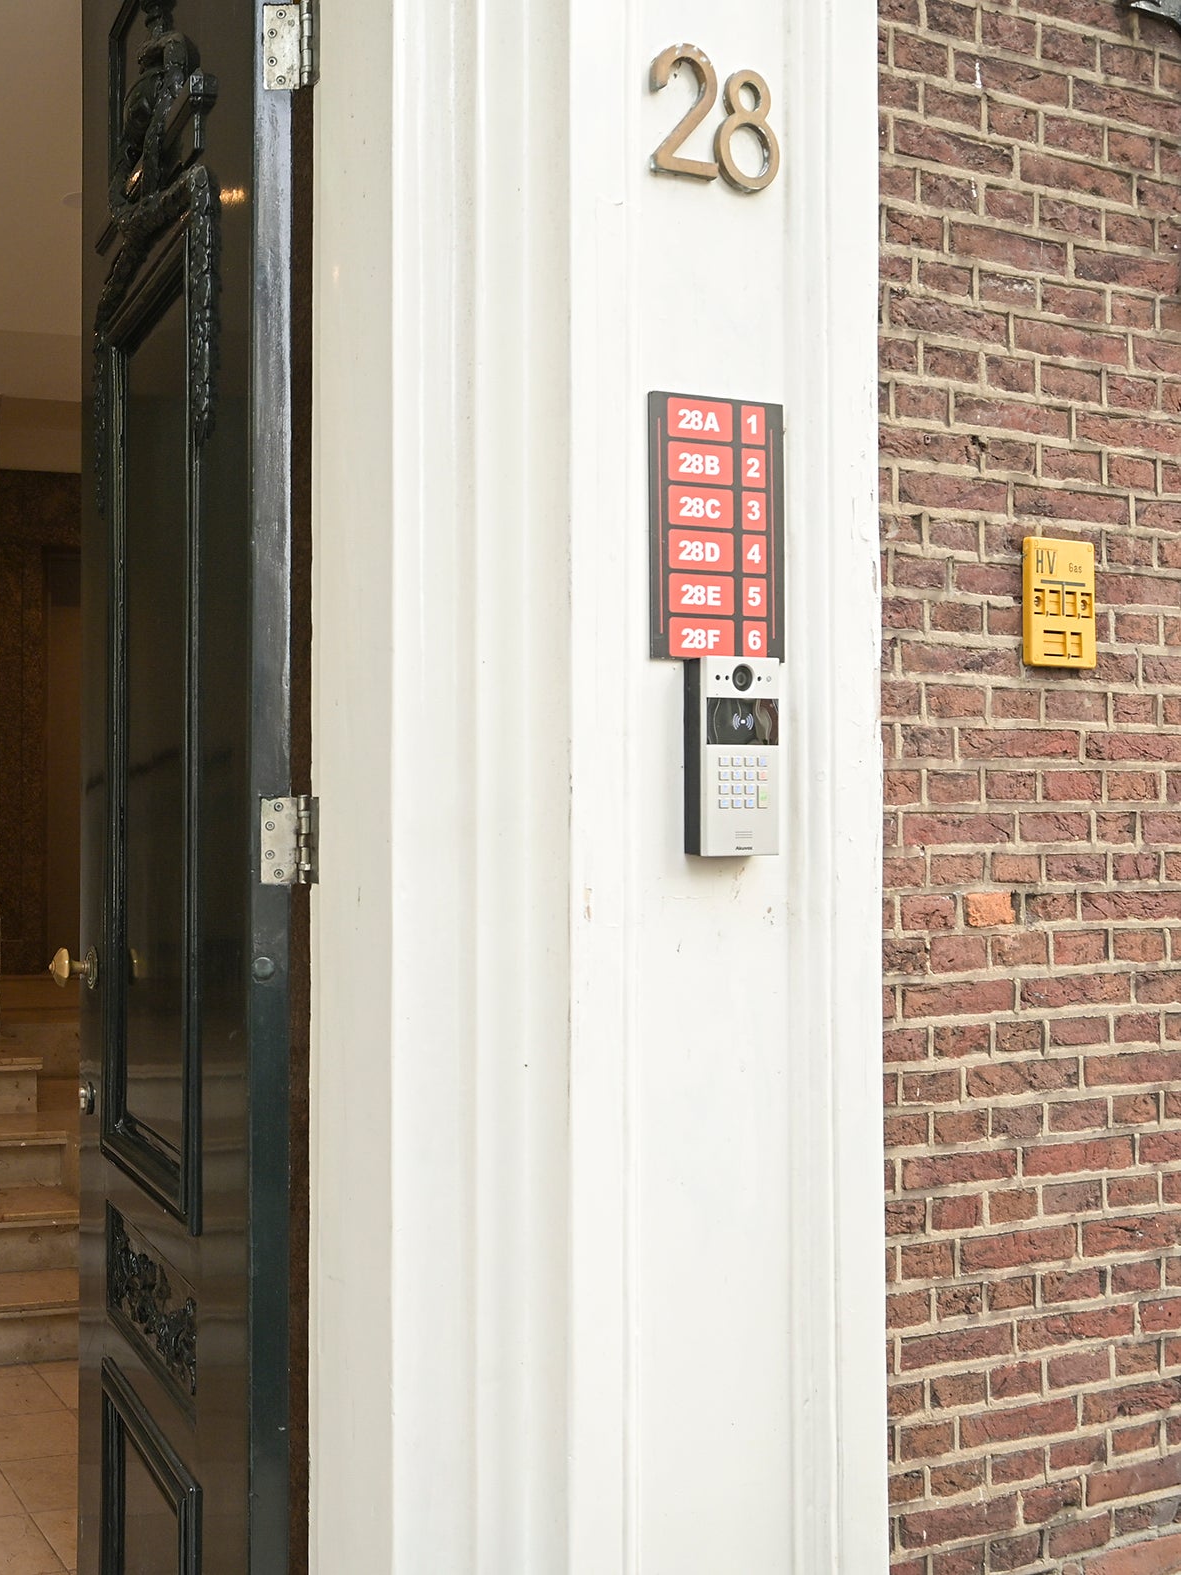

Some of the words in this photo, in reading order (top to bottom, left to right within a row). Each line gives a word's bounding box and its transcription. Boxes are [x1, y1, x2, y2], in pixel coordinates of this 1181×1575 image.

[649, 43, 780, 193] 28
[678, 408, 720, 433] 28A
[746, 414, 757, 435] 1
[678, 452, 721, 476] 28B
[746, 457, 761, 478] 2
[679, 496, 721, 519] 28C
[747, 500, 761, 521] 3
[678, 540, 721, 562] 28D
[746, 543, 761, 564] 4
[1035, 549, 1056, 575] HV
[1068, 562, 1083, 574] Gas
[680, 583, 722, 606] 28E
[747, 586, 762, 607] 5
[680, 627, 721, 650] 28F
[747, 629, 762, 651] 6
